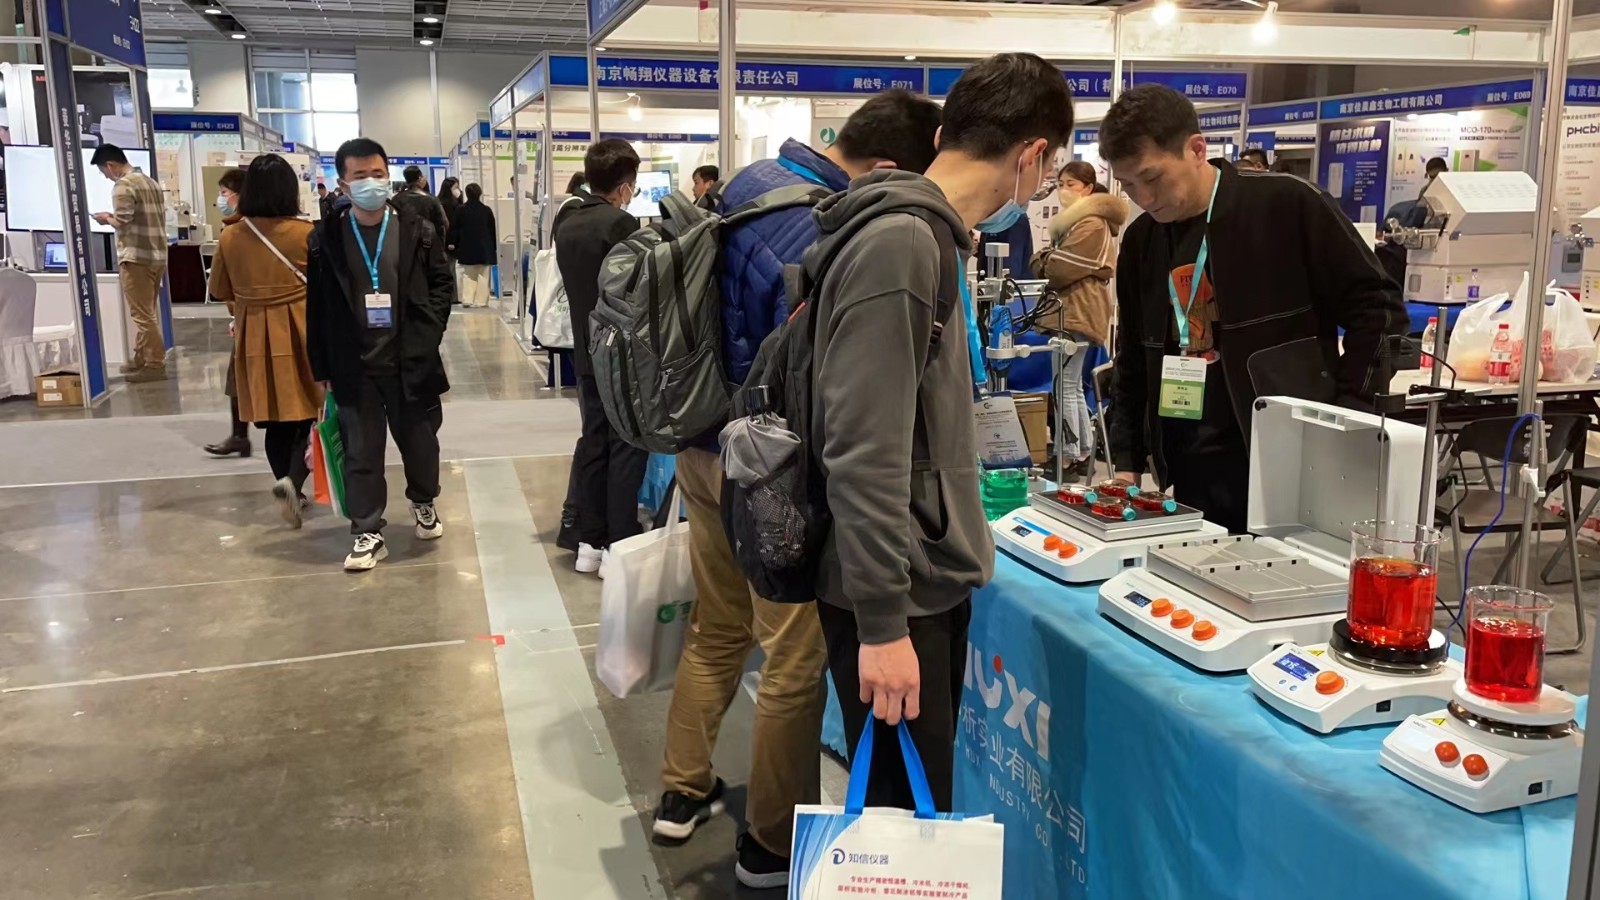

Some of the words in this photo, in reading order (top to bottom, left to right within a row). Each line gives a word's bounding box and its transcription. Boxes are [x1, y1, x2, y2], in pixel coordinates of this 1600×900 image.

[958, 700, 1086, 855] 析实业有限公司
[848, 853, 889, 865] 知信仪器
